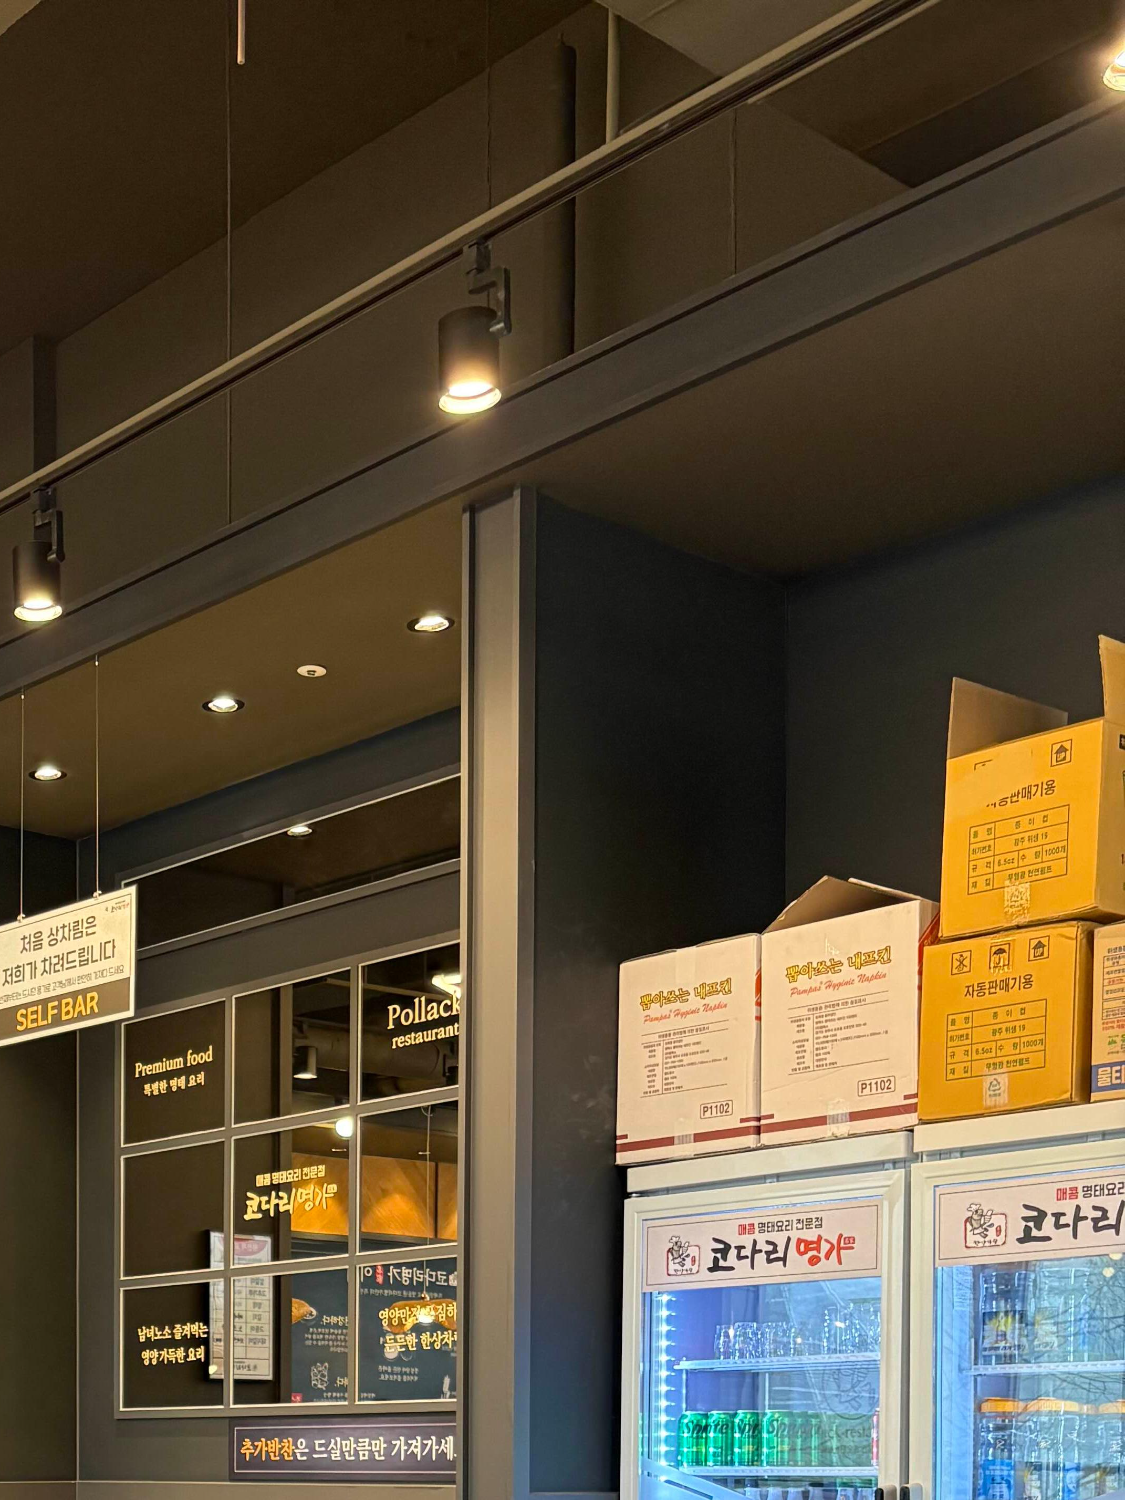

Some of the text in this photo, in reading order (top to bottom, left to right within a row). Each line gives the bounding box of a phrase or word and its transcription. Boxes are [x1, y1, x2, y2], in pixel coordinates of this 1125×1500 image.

[986, 779, 1056, 808] 판매기용
[20, 915, 97, 954] 처음 상차림은
[2, 938, 116, 987] 저희가 차려드립니다
[857, 970, 887, 984] Napkin
[964, 973, 1034, 999] 자동판매기용
[16, 991, 99, 1032] SELF BAR
[387, 990, 460, 1030] Pollack
[702, 1000, 728, 1013] Napkin
[391, 1022, 460, 1049] restaurant
[1022, 1038, 1044, 1048] 1000개
[135, 1045, 213, 1078] Premium food
[143, 1071, 205, 1097] 특별한 명태 요리
[860, 1079, 892, 1094] P1102
[702, 1102, 730, 1117] P1102
[271, 1168, 302, 1185] 명태요리
[302, 1164, 326, 1180] 전문점
[1056, 1186, 1079, 1202] 매콤
[737, 1216, 824, 1236] 매콤 명태요리 전문점
[137, 1321, 209, 1342] 남녀노소 즐겨먹는
[384, 1330, 457, 1353] 든든한 한상차
[141, 1345, 205, 1366] 영양 가득한 요리
[240, 1435, 457, 1462] 추가반찬은 드실만큼만 가져가세
